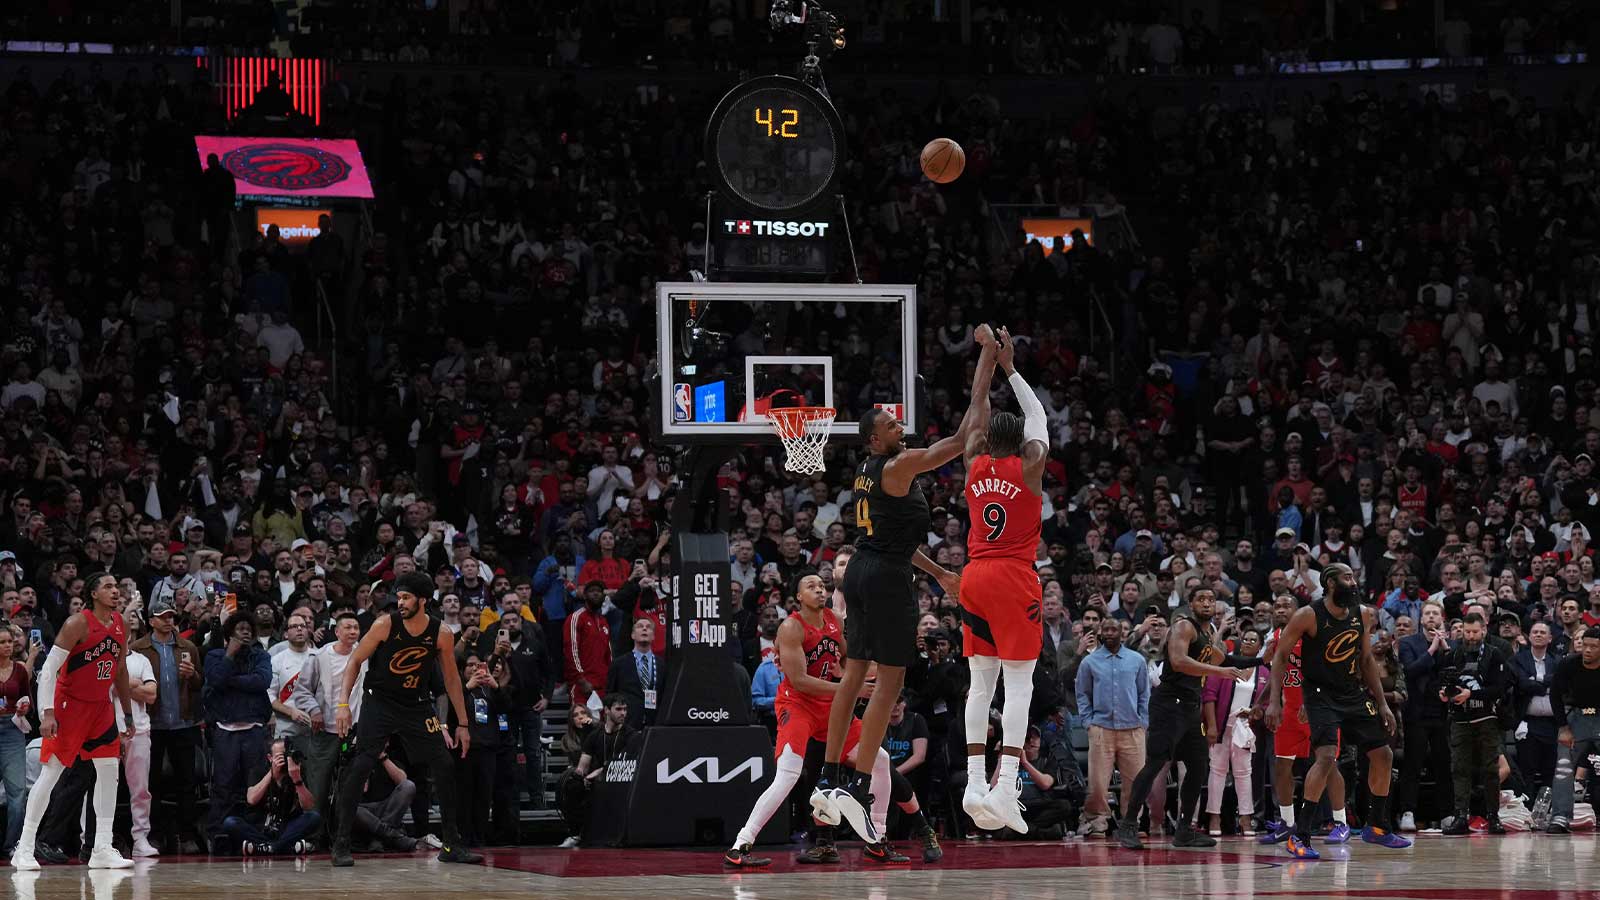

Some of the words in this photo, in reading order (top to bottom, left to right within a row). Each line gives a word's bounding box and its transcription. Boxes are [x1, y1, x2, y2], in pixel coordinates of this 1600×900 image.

[754, 107, 799, 138] 4.2
[753, 221, 829, 237] TISSOT
[970, 478, 1022, 500] BARRETT
[856, 496, 874, 537] 4
[982, 502, 1007, 541] 9
[694, 573, 720, 595] GET
[694, 597, 720, 618] THE
[700, 620, 726, 647] App
[97, 660, 112, 680] 12
[687, 707, 730, 722] Google
[656, 756, 763, 784] KIA
